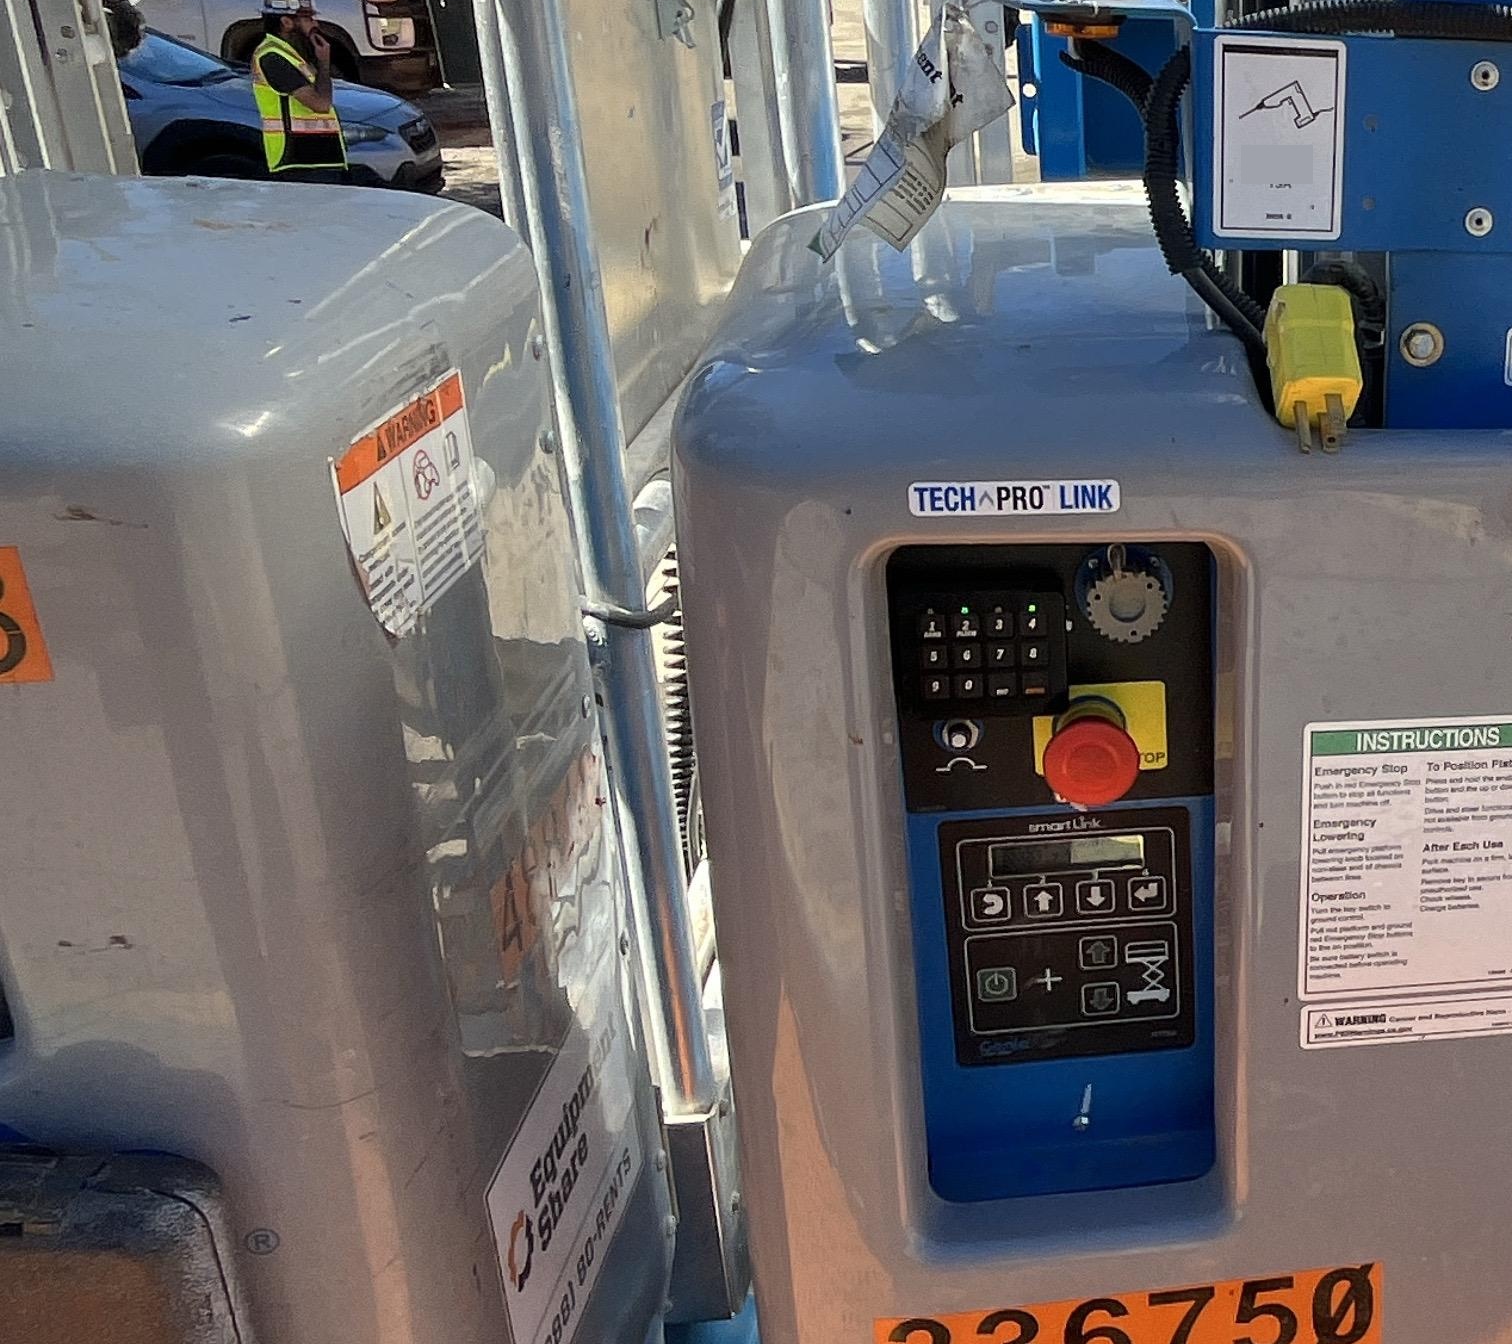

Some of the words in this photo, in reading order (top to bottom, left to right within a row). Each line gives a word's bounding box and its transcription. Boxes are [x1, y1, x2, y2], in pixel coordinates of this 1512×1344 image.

[914, 486, 975, 512] TECH
[1059, 485, 1113, 509] LINK
[962, 620, 969, 630] 2
[996, 619, 1003, 630] 3
[1029, 618, 1036, 629] 4
[931, 651, 937, 661] 5
[963, 650, 970, 661] 6
[997, 649, 1004, 660] 7
[1030, 648, 1037, 659] 8
[932, 681, 939, 692] 9
[1357, 727, 1500, 751] INSTRUCTIONS
[1315, 766, 1377, 777] Emergency
[1382, 765, 1407, 774] Stop
[1427, 762, 1440, 771] To
[1444, 760, 1487, 770] Position
[1314, 819, 1376, 829] Emergency
[1313, 832, 1364, 842] Lowering
[1423, 844, 1449, 852] After
[1453, 842, 1479, 851] Each
[1483, 841, 1503, 849] Use
[1312, 891, 1365, 904] Operation
[1335, 1014, 1386, 1026] WARNING
[537, 1131, 589, 1252] Share
